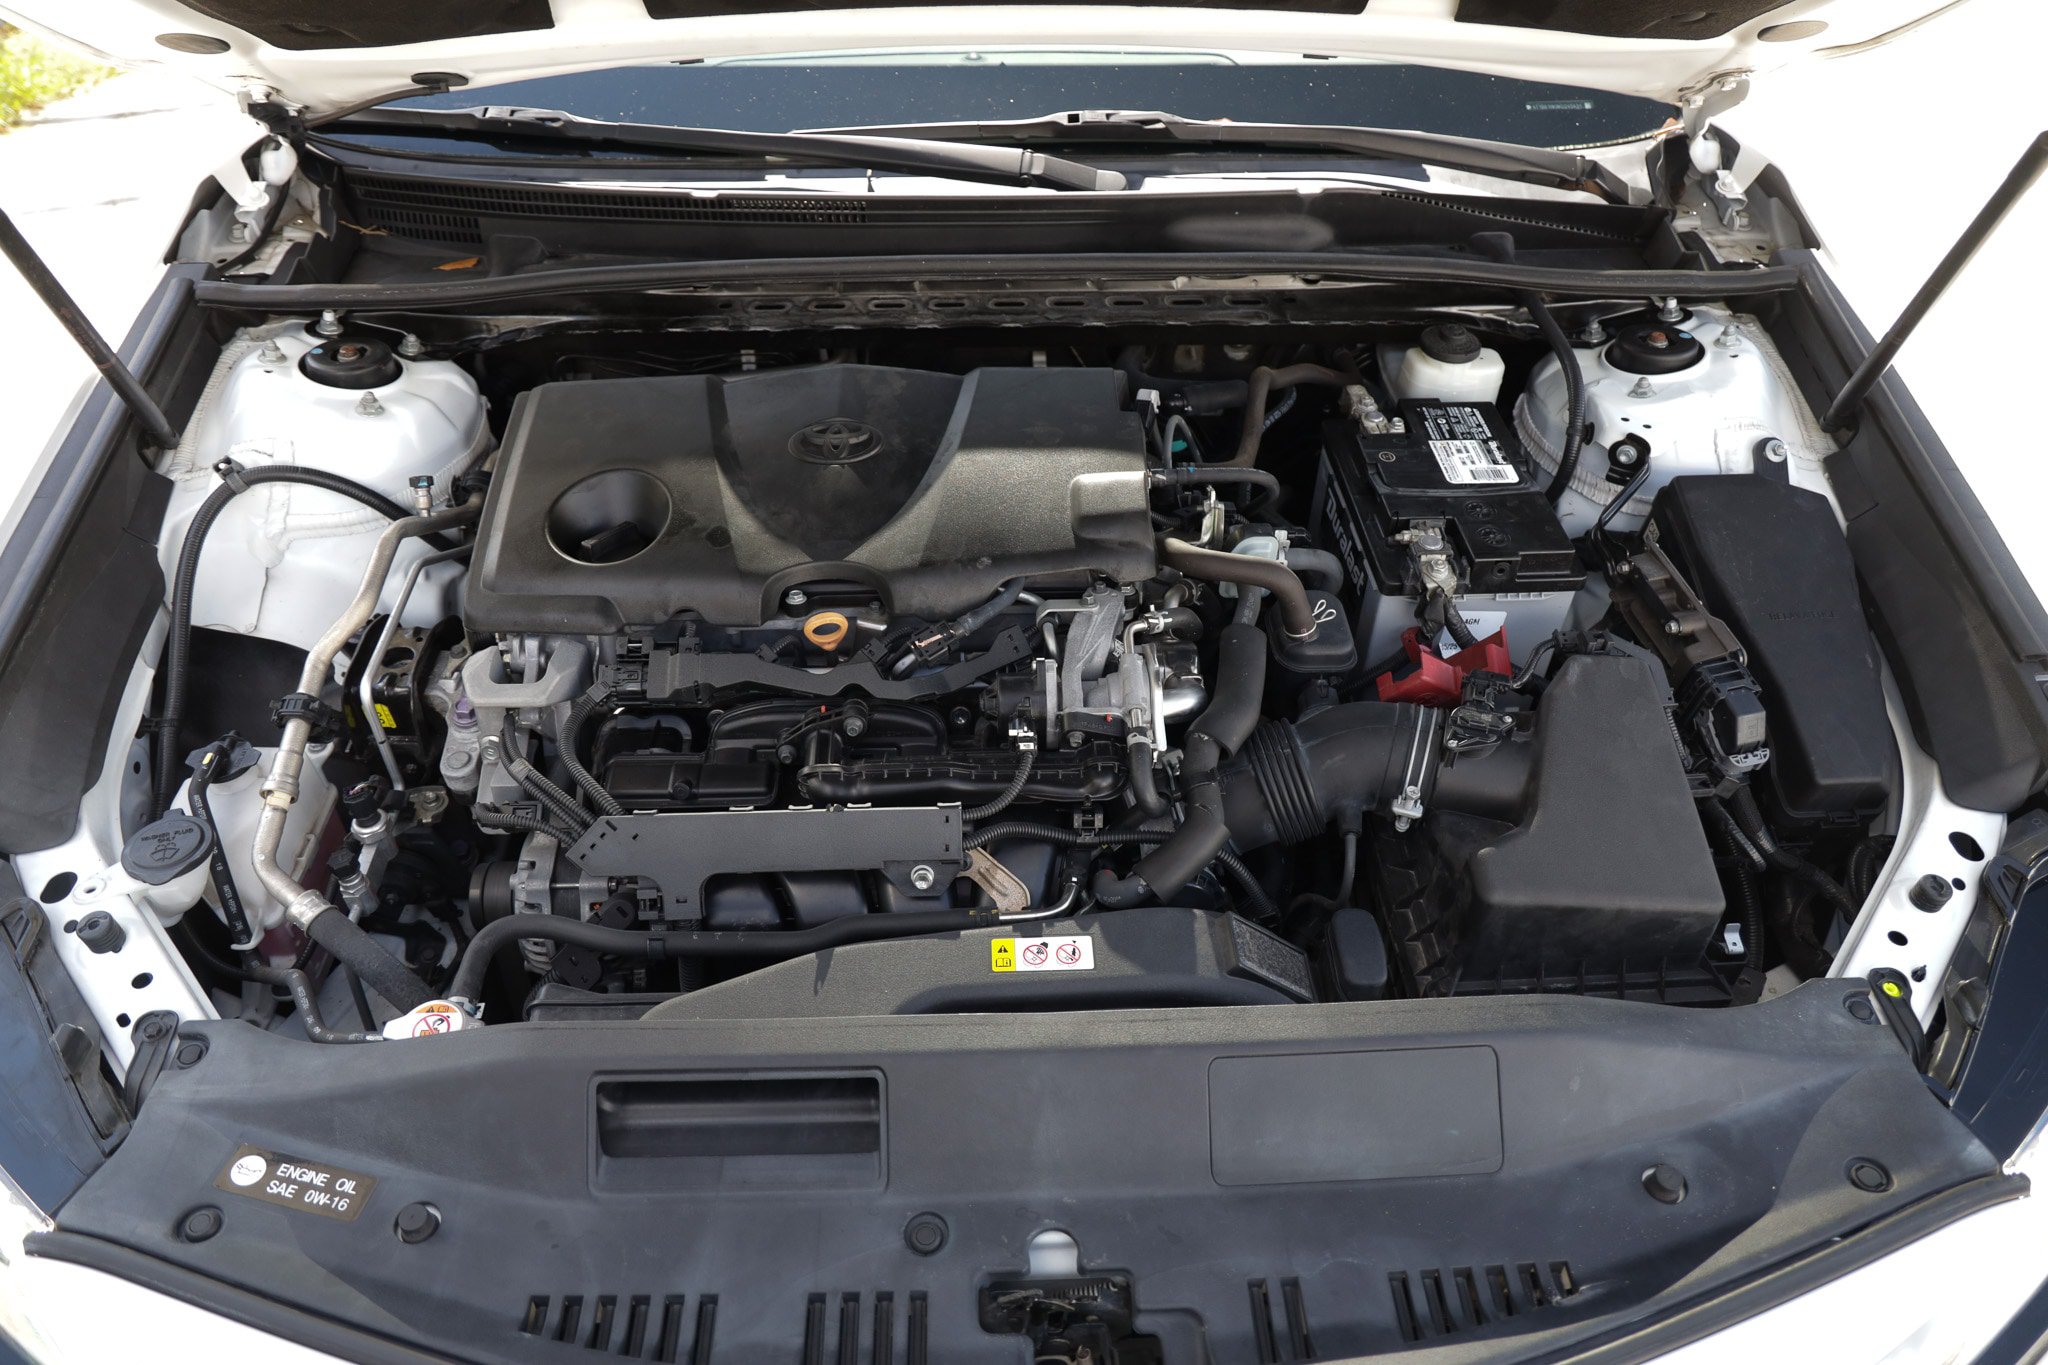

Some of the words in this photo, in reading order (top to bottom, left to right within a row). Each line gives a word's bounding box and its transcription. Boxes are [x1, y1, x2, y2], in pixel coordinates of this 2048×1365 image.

[1326, 487, 1364, 596] Duralast
[276, 1163, 331, 1187] ENGINE
[335, 1178, 357, 1195] OIL
[266, 1180, 299, 1198] SAE
[304, 1189, 350, 1211] 0W-16
